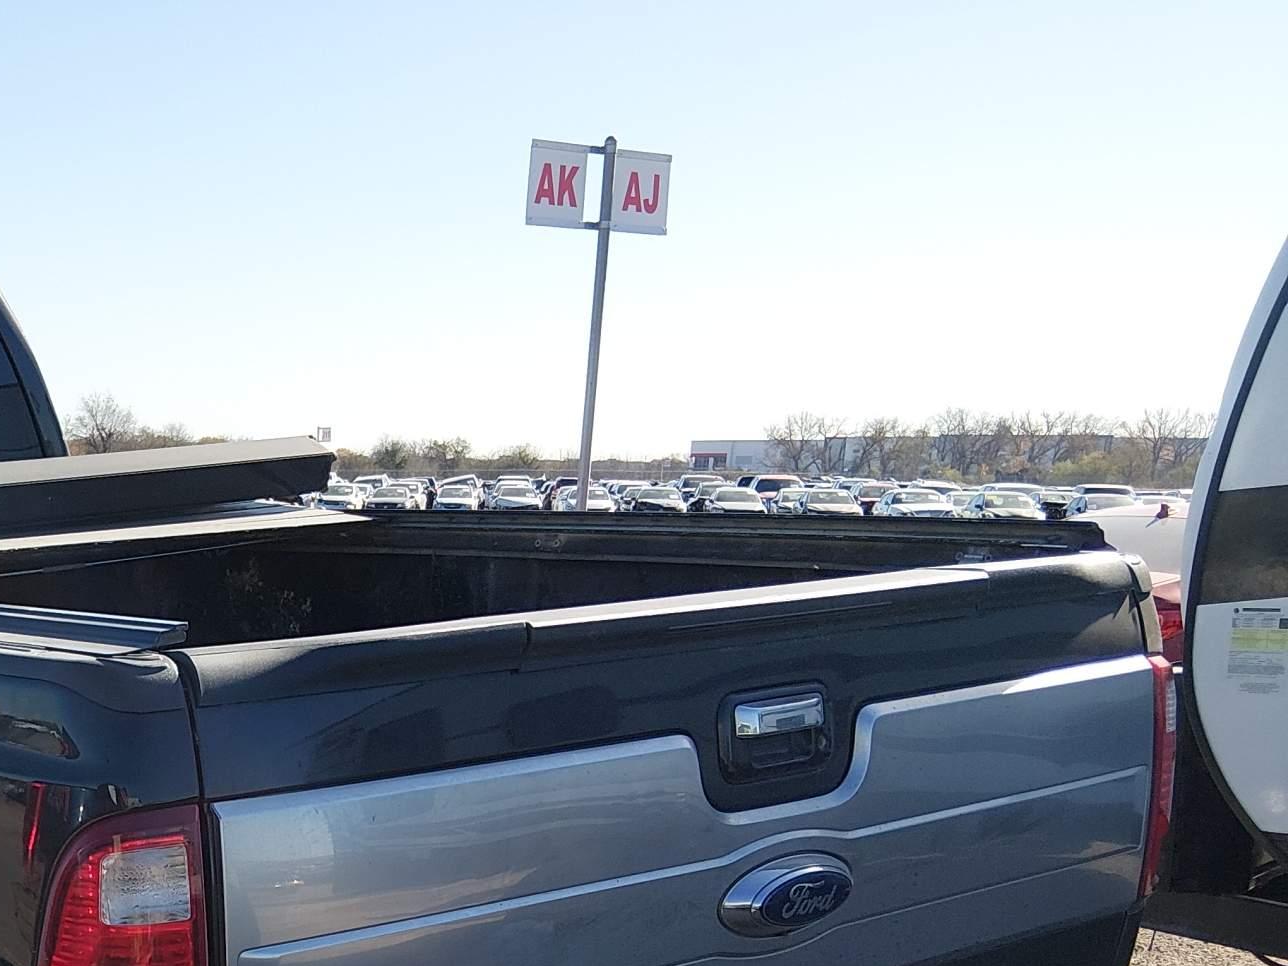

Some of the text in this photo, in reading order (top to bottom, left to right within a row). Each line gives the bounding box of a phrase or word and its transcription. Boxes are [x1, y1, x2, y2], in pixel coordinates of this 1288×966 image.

[533, 162, 580, 208] AK
[621, 170, 661, 214] AJ
[782, 880, 837, 919] Ford
